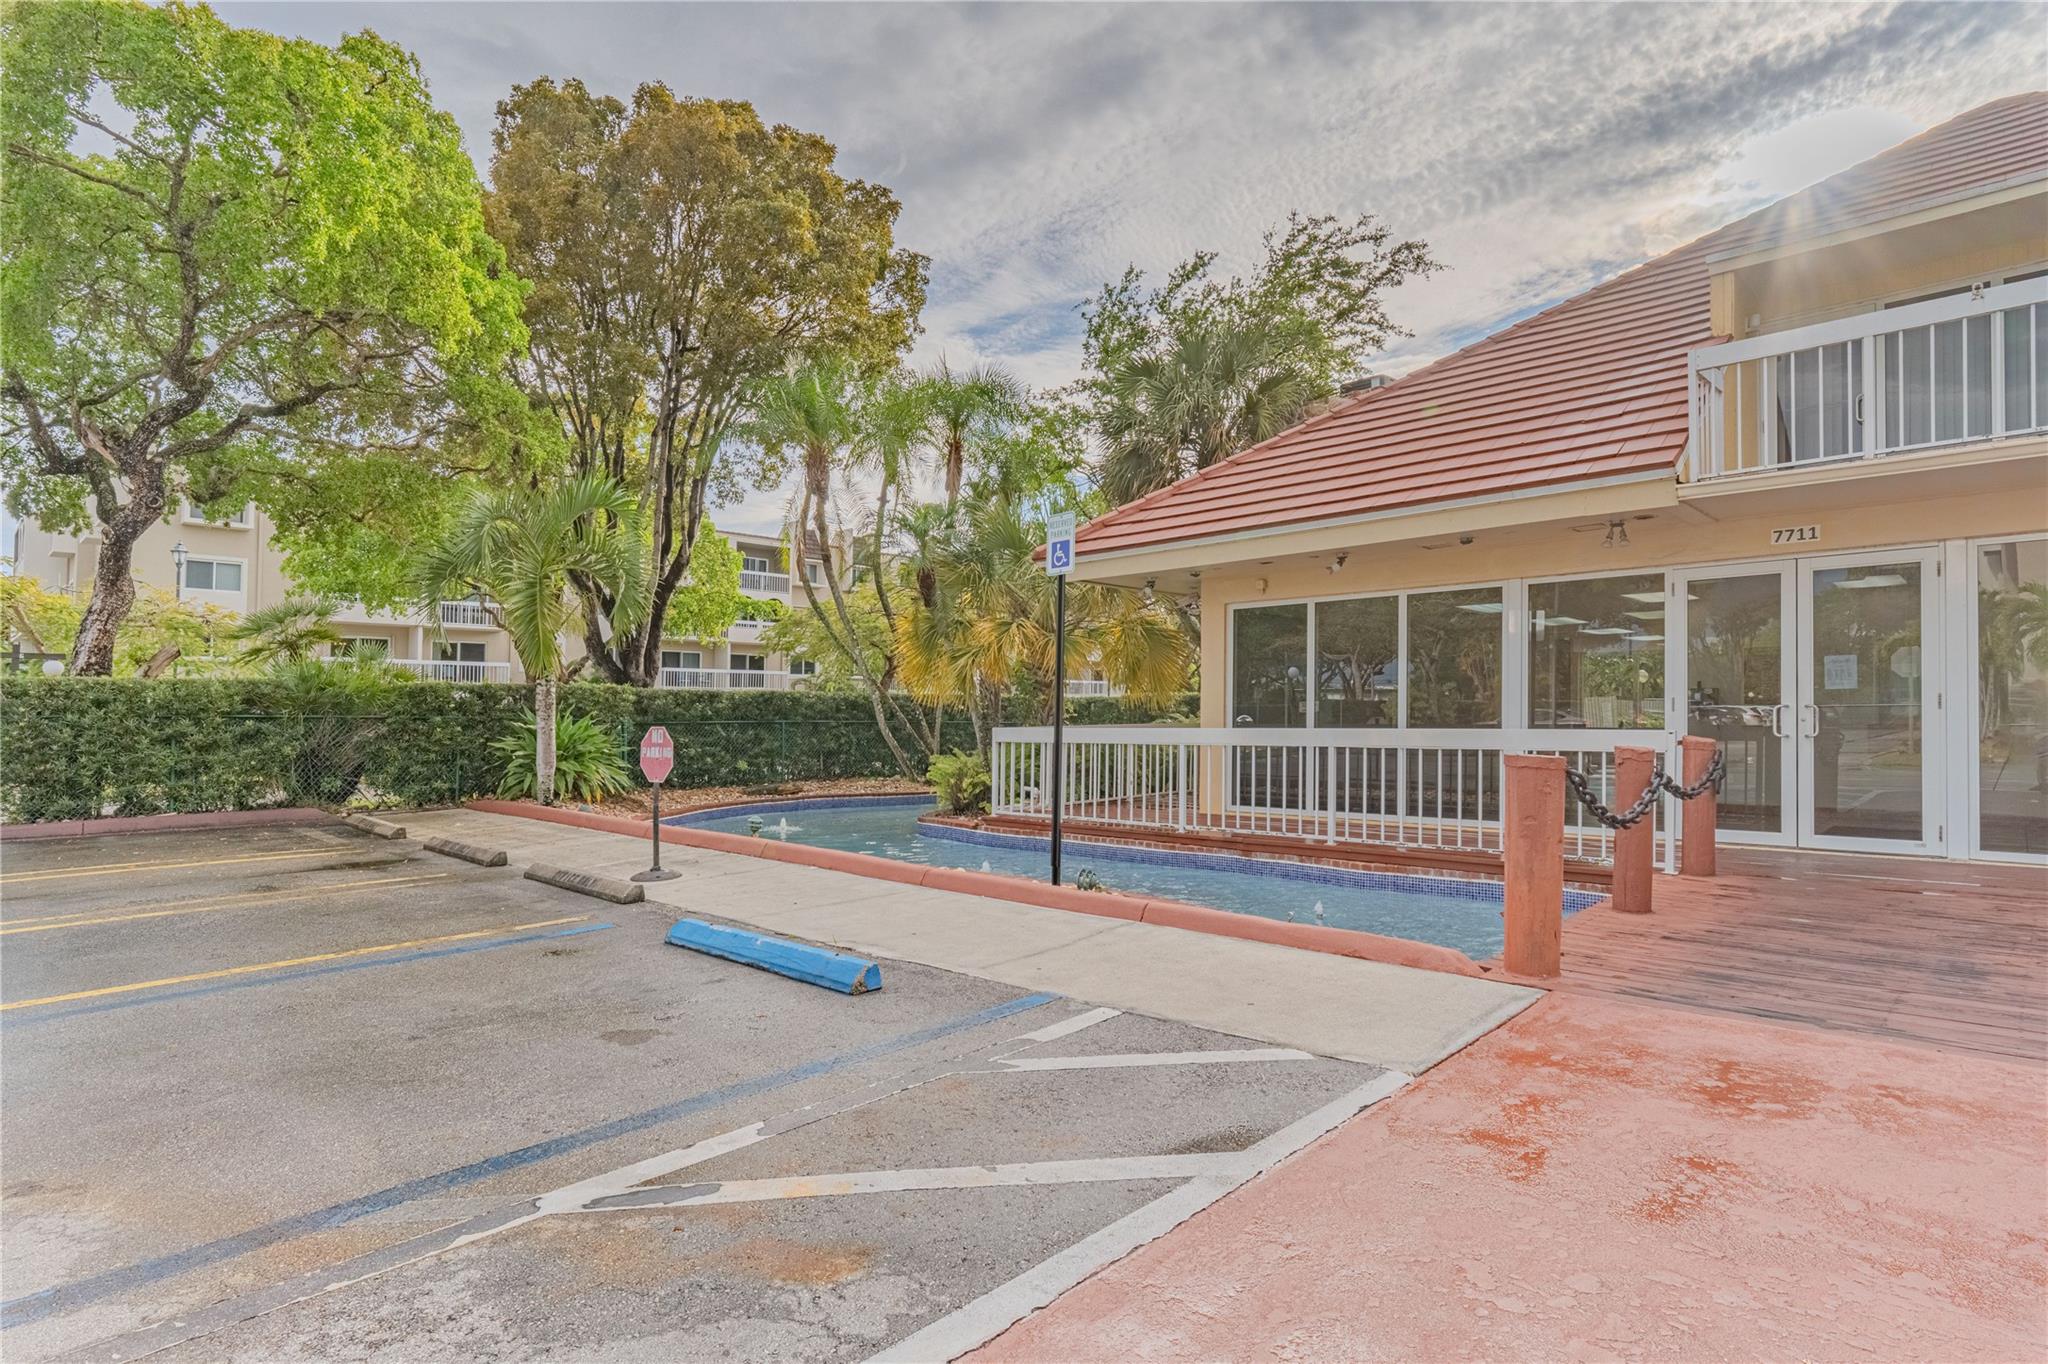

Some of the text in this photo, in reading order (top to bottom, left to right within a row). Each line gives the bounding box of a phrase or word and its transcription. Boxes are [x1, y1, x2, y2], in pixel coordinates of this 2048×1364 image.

[1050, 529, 1071, 539] PARKING
[1773, 527, 1819, 543] 7711
[652, 729, 663, 743] NO
[641, 747, 672, 758] PARKING
